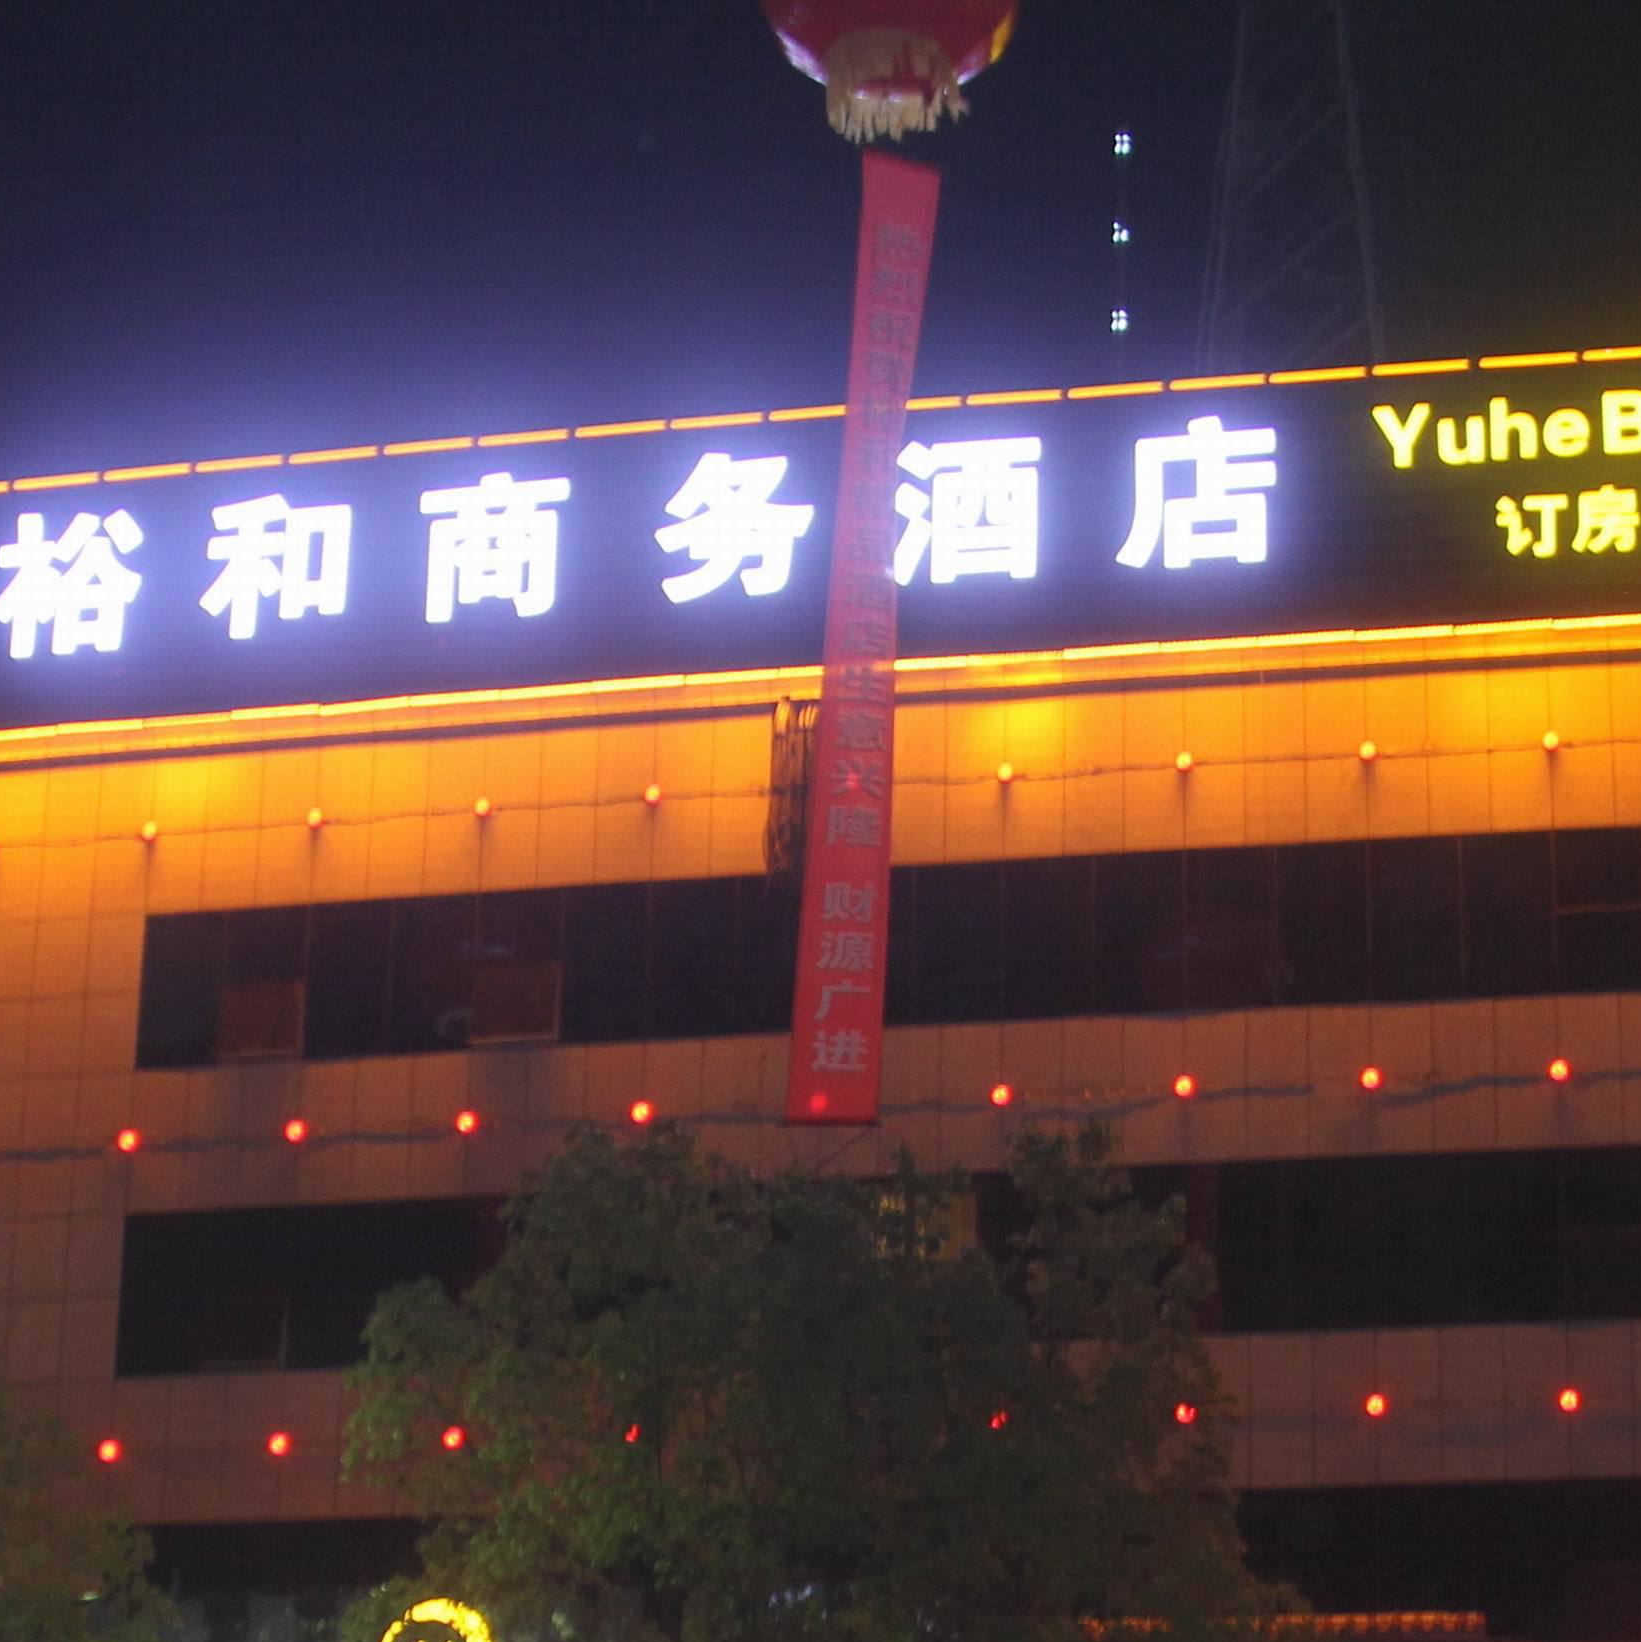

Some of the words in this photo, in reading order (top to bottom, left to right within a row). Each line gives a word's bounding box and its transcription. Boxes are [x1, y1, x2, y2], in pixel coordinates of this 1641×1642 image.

[1371, 397, 1591, 469] Yuhe
[811, 882, 880, 1073] 财源广进
